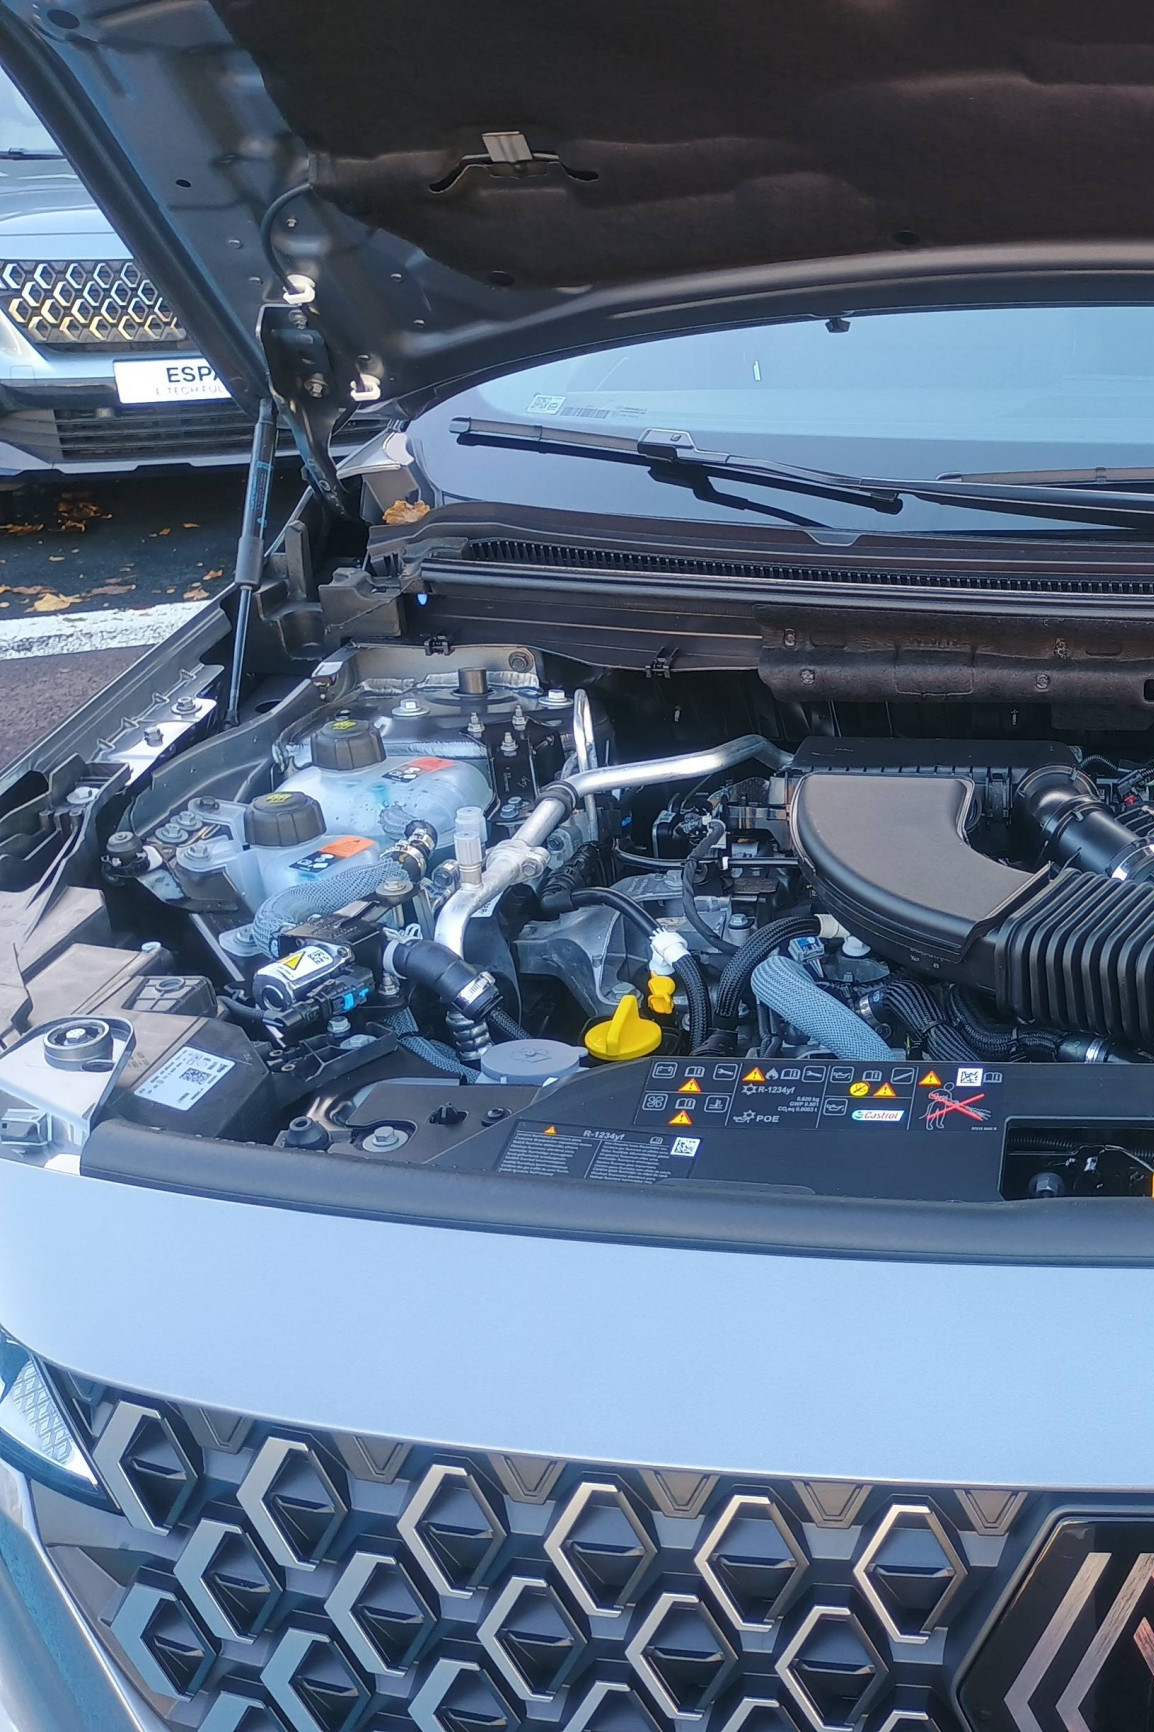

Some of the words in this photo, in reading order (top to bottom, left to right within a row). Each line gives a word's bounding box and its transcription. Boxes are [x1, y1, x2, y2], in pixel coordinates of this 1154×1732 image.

[758, 1085, 796, 1095] R-1234yf
[864, 1111, 899, 1119] Castrol
[582, 1128, 625, 1141] R-1234yf
